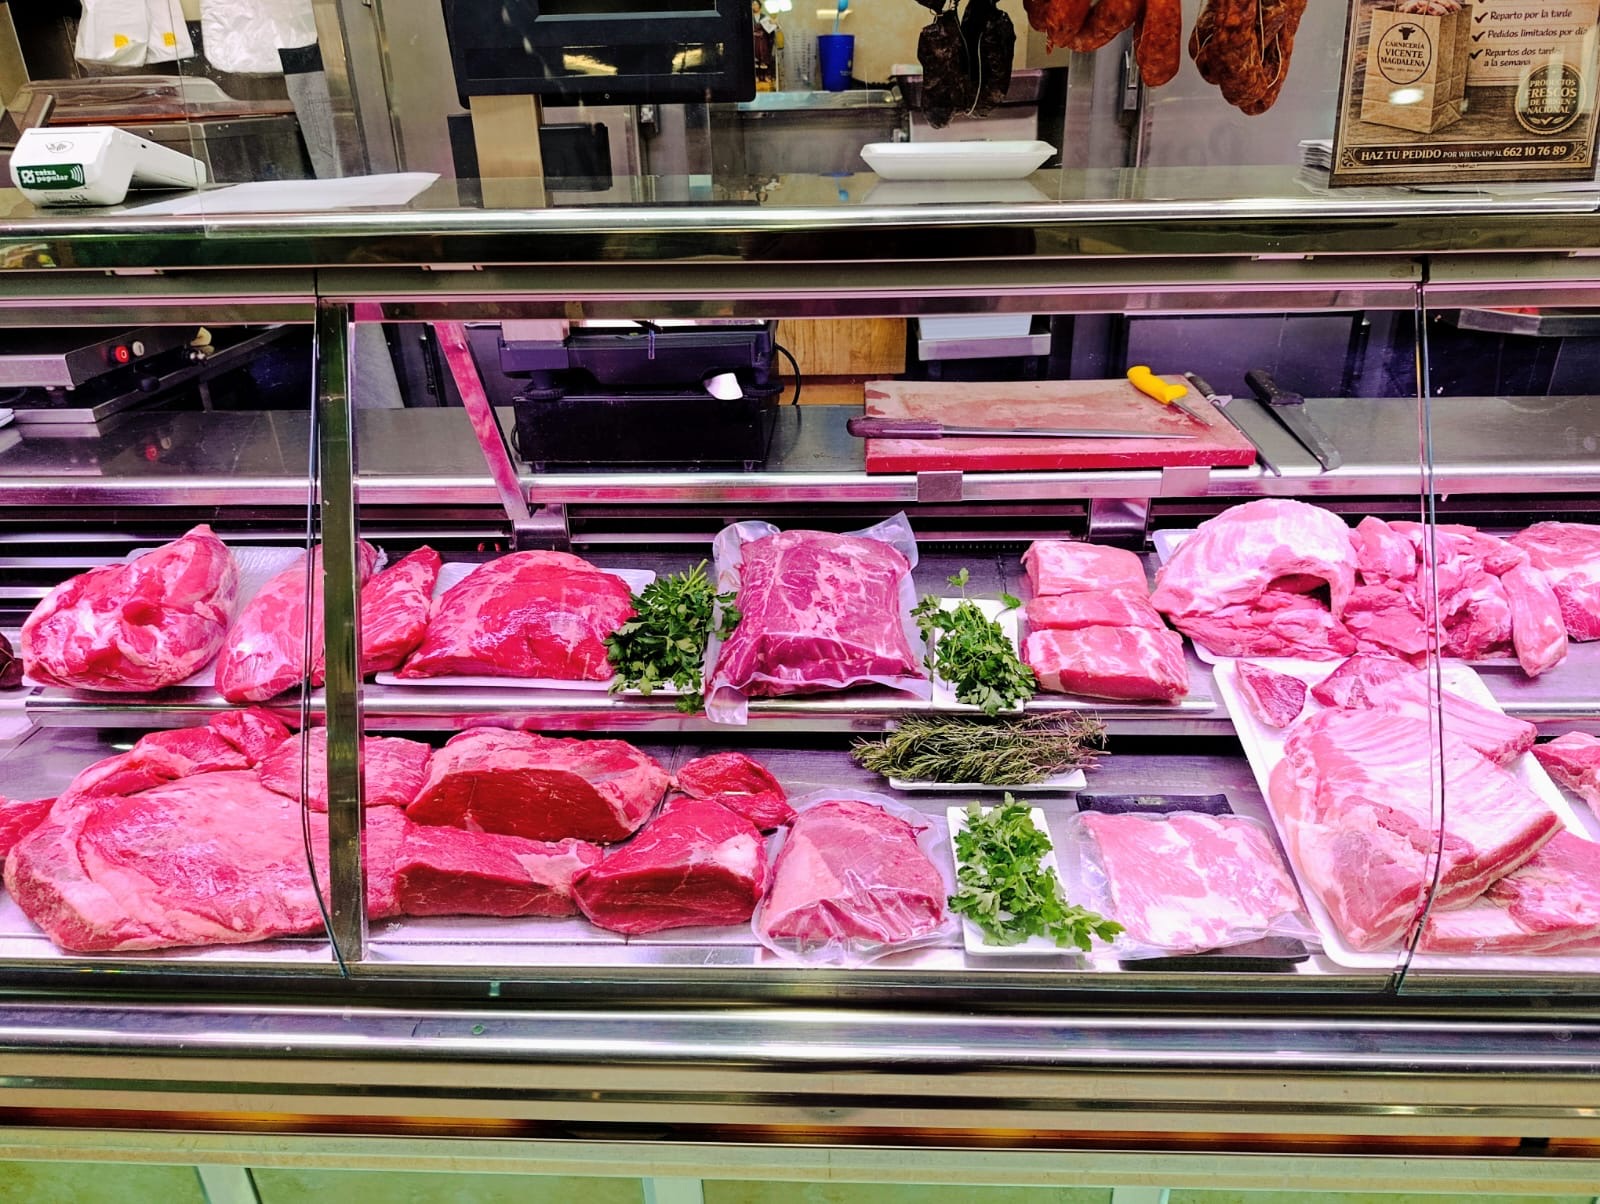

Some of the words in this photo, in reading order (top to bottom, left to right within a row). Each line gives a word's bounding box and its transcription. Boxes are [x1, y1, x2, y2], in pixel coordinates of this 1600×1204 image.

[1490, 11, 1522, 21] Reparto
[1524, 12, 1538, 21] por
[1541, 10, 1549, 18] la
[1551, 9, 1572, 18] tarde
[1488, 30, 1519, 38] Pedidos
[1520, 29, 1557, 38] limitados
[1559, 30, 1573, 38] por
[1386, 48, 1424, 58] VICENTE
[1485, 48, 1519, 58] Repartos
[1521, 48, 1536, 56] dos
[1380, 56, 1425, 67] MAGDALENA
[1525, 86, 1577, 98] FRESCOS
[1527, 106, 1570, 114] NACIONAL
[1361, 151, 1384, 161] HAZ
[1386, 150, 1400, 160] TU
[1402, 150, 1442, 160] PEDIDO
[1503, 147, 1522, 157] 662
[1524, 147, 1536, 156] 10
[1538, 146, 1550, 156] 76
[1552, 146, 1567, 156] 89
